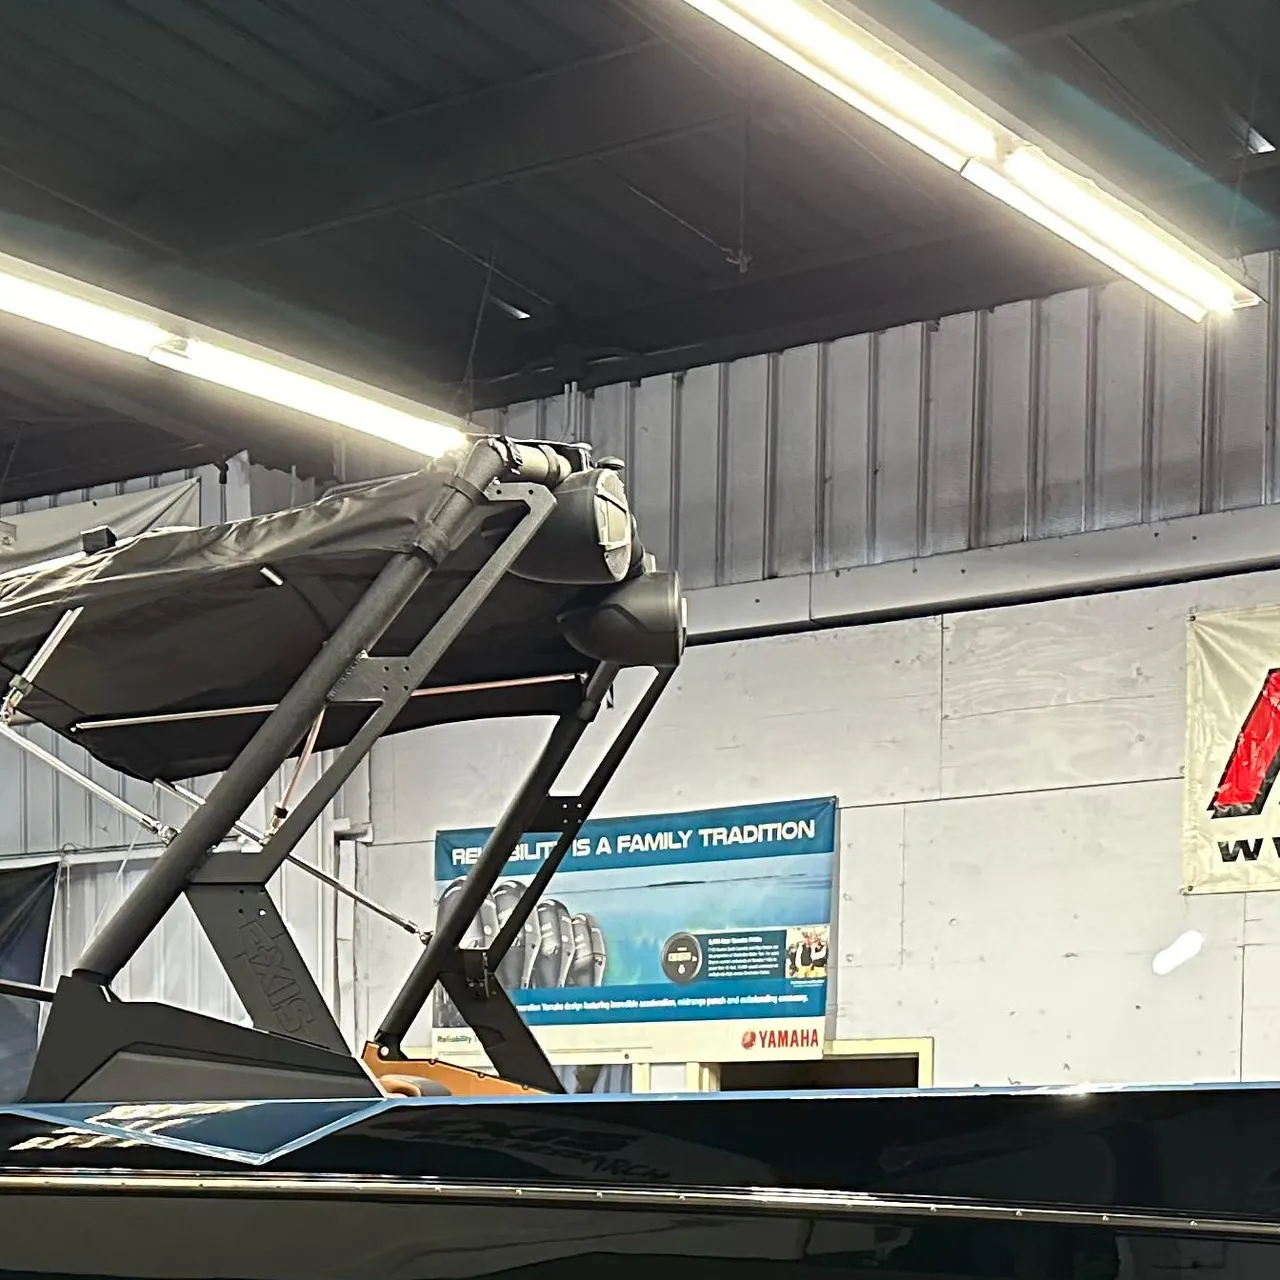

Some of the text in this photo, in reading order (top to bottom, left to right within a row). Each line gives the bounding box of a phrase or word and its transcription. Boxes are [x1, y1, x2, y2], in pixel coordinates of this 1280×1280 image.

[572, 838, 591, 857] IS
[595, 836, 612, 855] A
[617, 829, 693, 853] FAMILY
[698, 819, 816, 847] TRADITION
[759, 1029, 819, 1048] YAMAHA
